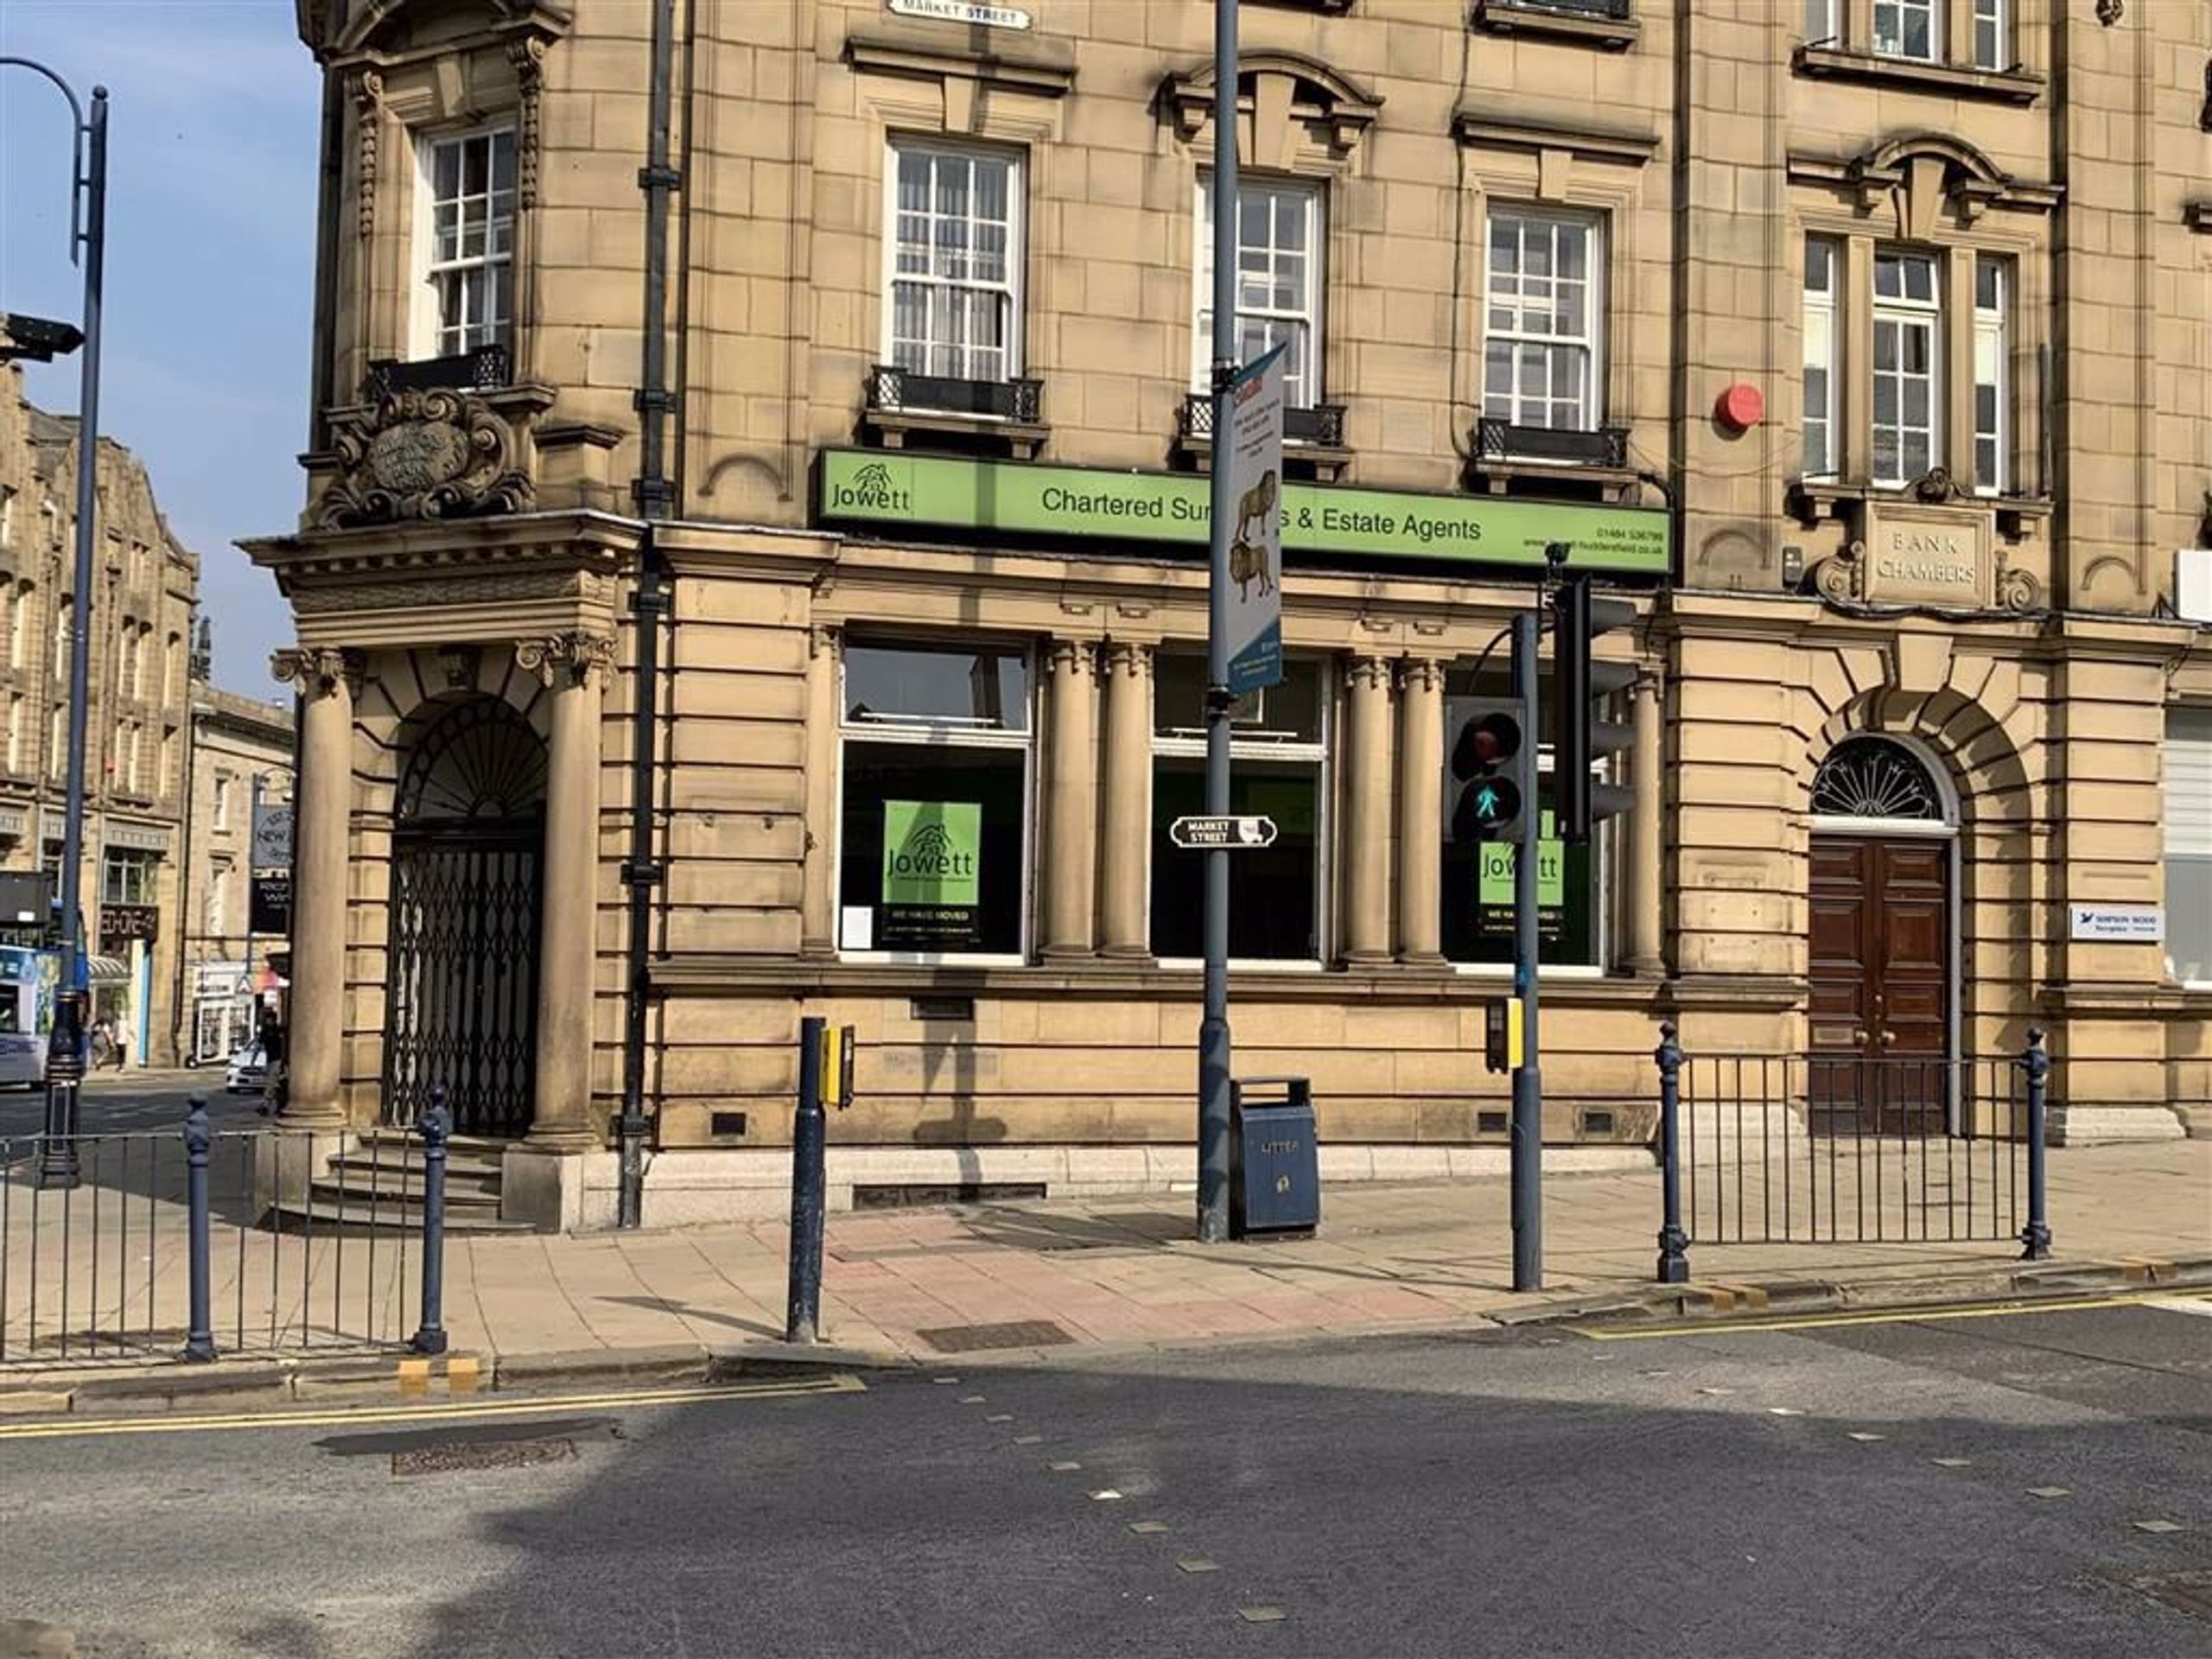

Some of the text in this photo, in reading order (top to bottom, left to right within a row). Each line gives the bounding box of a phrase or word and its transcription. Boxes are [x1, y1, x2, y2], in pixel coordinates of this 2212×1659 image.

[903, 0, 1018, 23] MARKET STREET
[832, 483, 909, 511] Jowett
[1042, 487, 1163, 518] Chartered
[1298, 506, 1313, 529] &
[1323, 508, 1395, 534] Estate
[1402, 514, 1482, 543] Agents
[1893, 532, 1958, 555] BANK
[1878, 561, 1975, 584] CHAMBERS
[1188, 820, 1229, 831] MARKET
[1190, 832, 1227, 842] STREET
[887, 849, 974, 877] Jowett
[1482, 854, 1557, 878] Jott
[1262, 1141, 1300, 1154] LITTER
